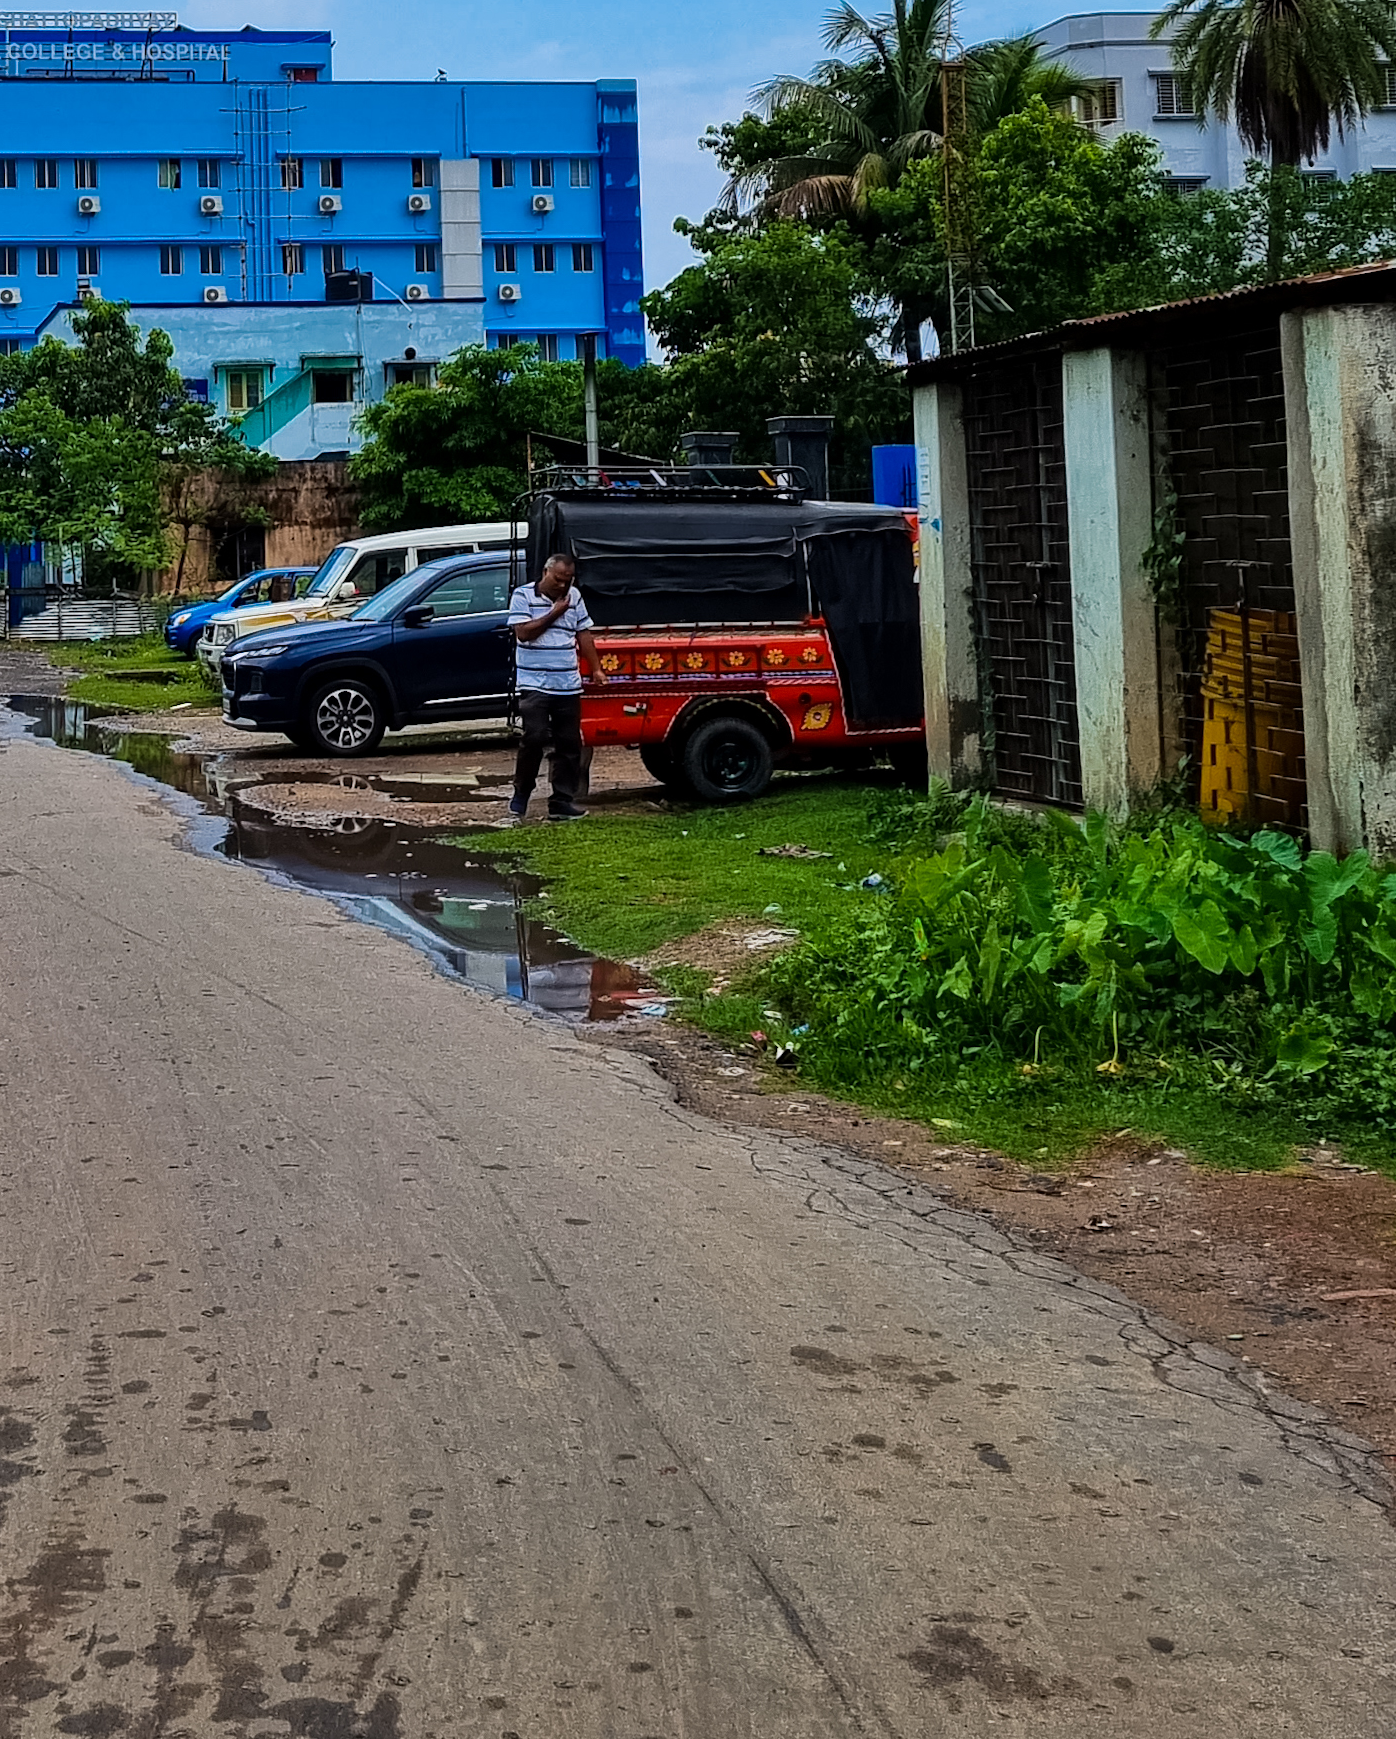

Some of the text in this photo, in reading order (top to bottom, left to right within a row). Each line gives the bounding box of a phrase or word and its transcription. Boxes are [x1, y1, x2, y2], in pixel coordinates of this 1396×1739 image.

[7, 43, 104, 60] COLLEGE
[112, 43, 126, 61] &
[132, 43, 231, 61] HOSPITAL
